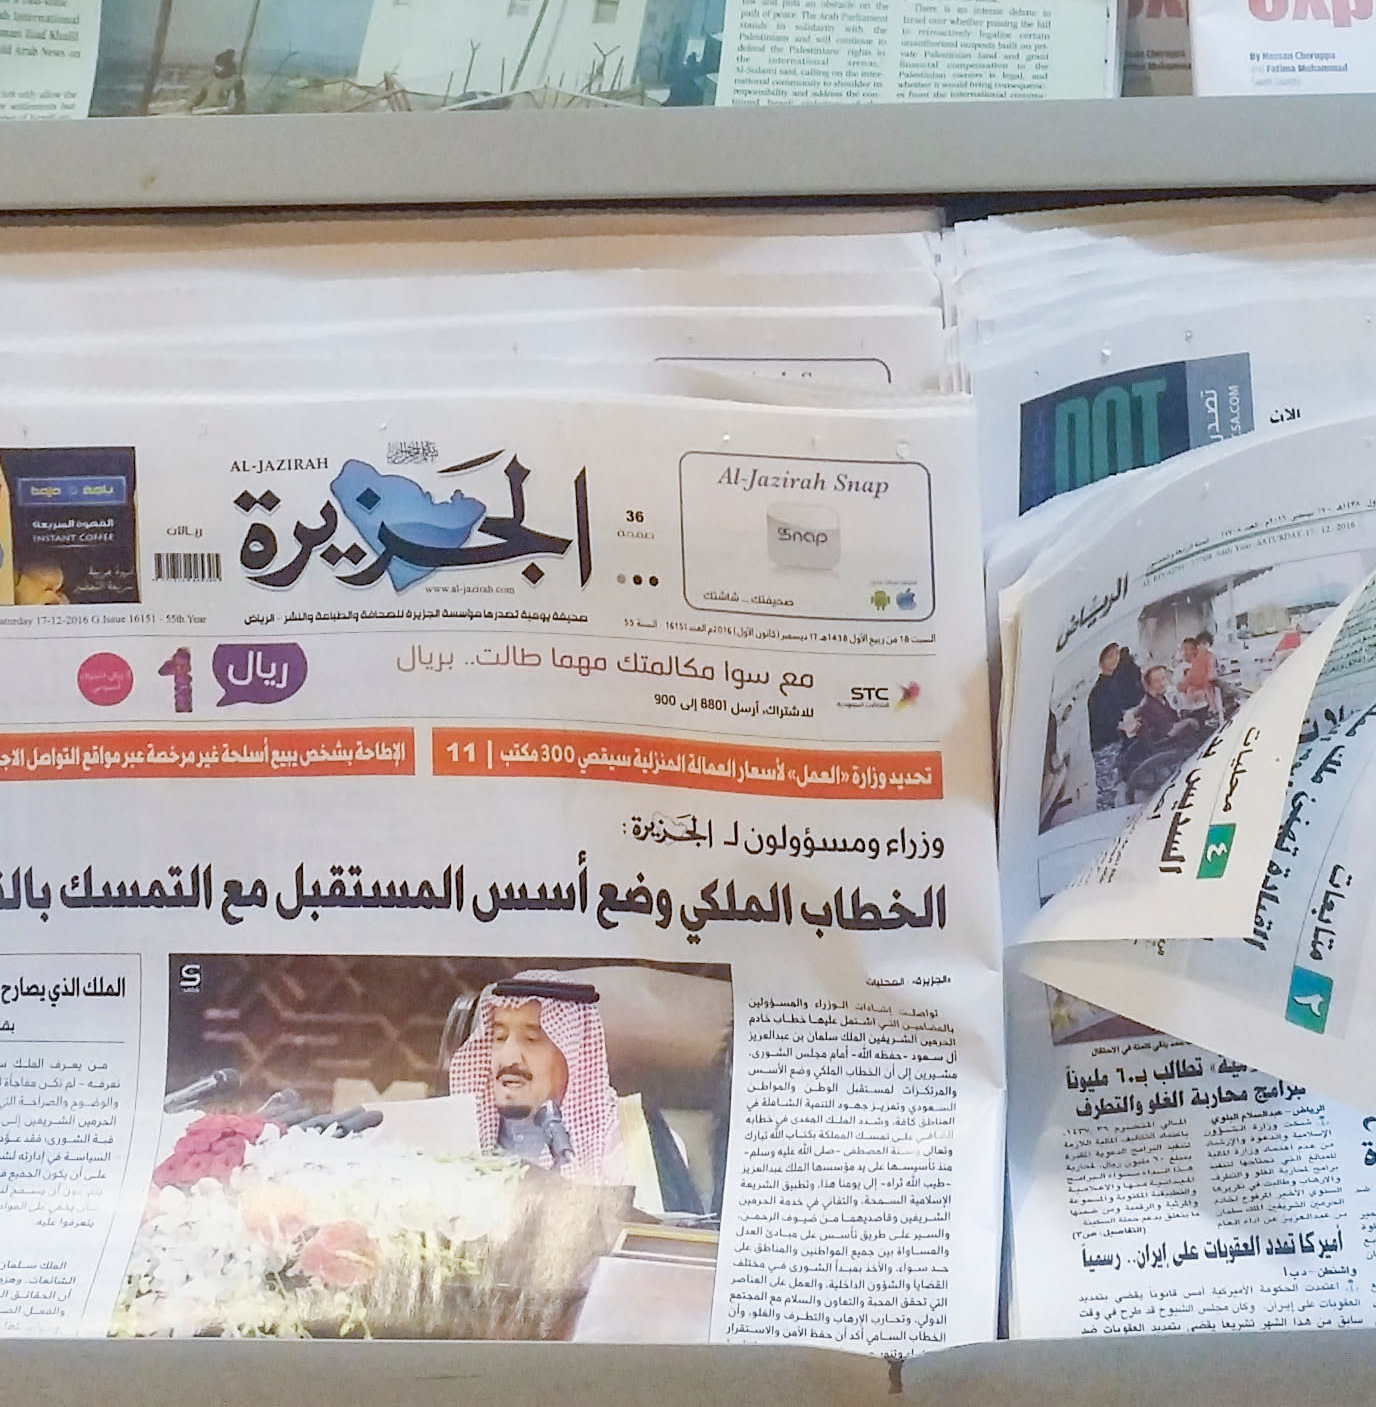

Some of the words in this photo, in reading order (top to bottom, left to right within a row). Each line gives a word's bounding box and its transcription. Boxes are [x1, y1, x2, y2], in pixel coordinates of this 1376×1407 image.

[230, 456, 329, 473] AL-JAZIRAH
[717, 465, 827, 493] Al-Jazirah
[833, 469, 890, 498] Snap
[625, 510, 645, 524] 36
[227, 650, 290, 690] ريال
[397, 647, 455, 672] بريال
[552, 647, 607, 672] مهما
[617, 653, 715, 680] مكالمتك
[723, 661, 769, 690] سوا
[779, 672, 814, 695] مع
[850, 686, 889, 701] STC
[59, 863, 212, 911] التمسك
[221, 878, 268, 925] مع
[275, 862, 464, 922] المستقبل
[472, 850, 588, 923] أسس
[596, 873, 673, 932] وضع
[680, 880, 793, 945] الملكي
[802, 882, 947, 939] الخطاب
